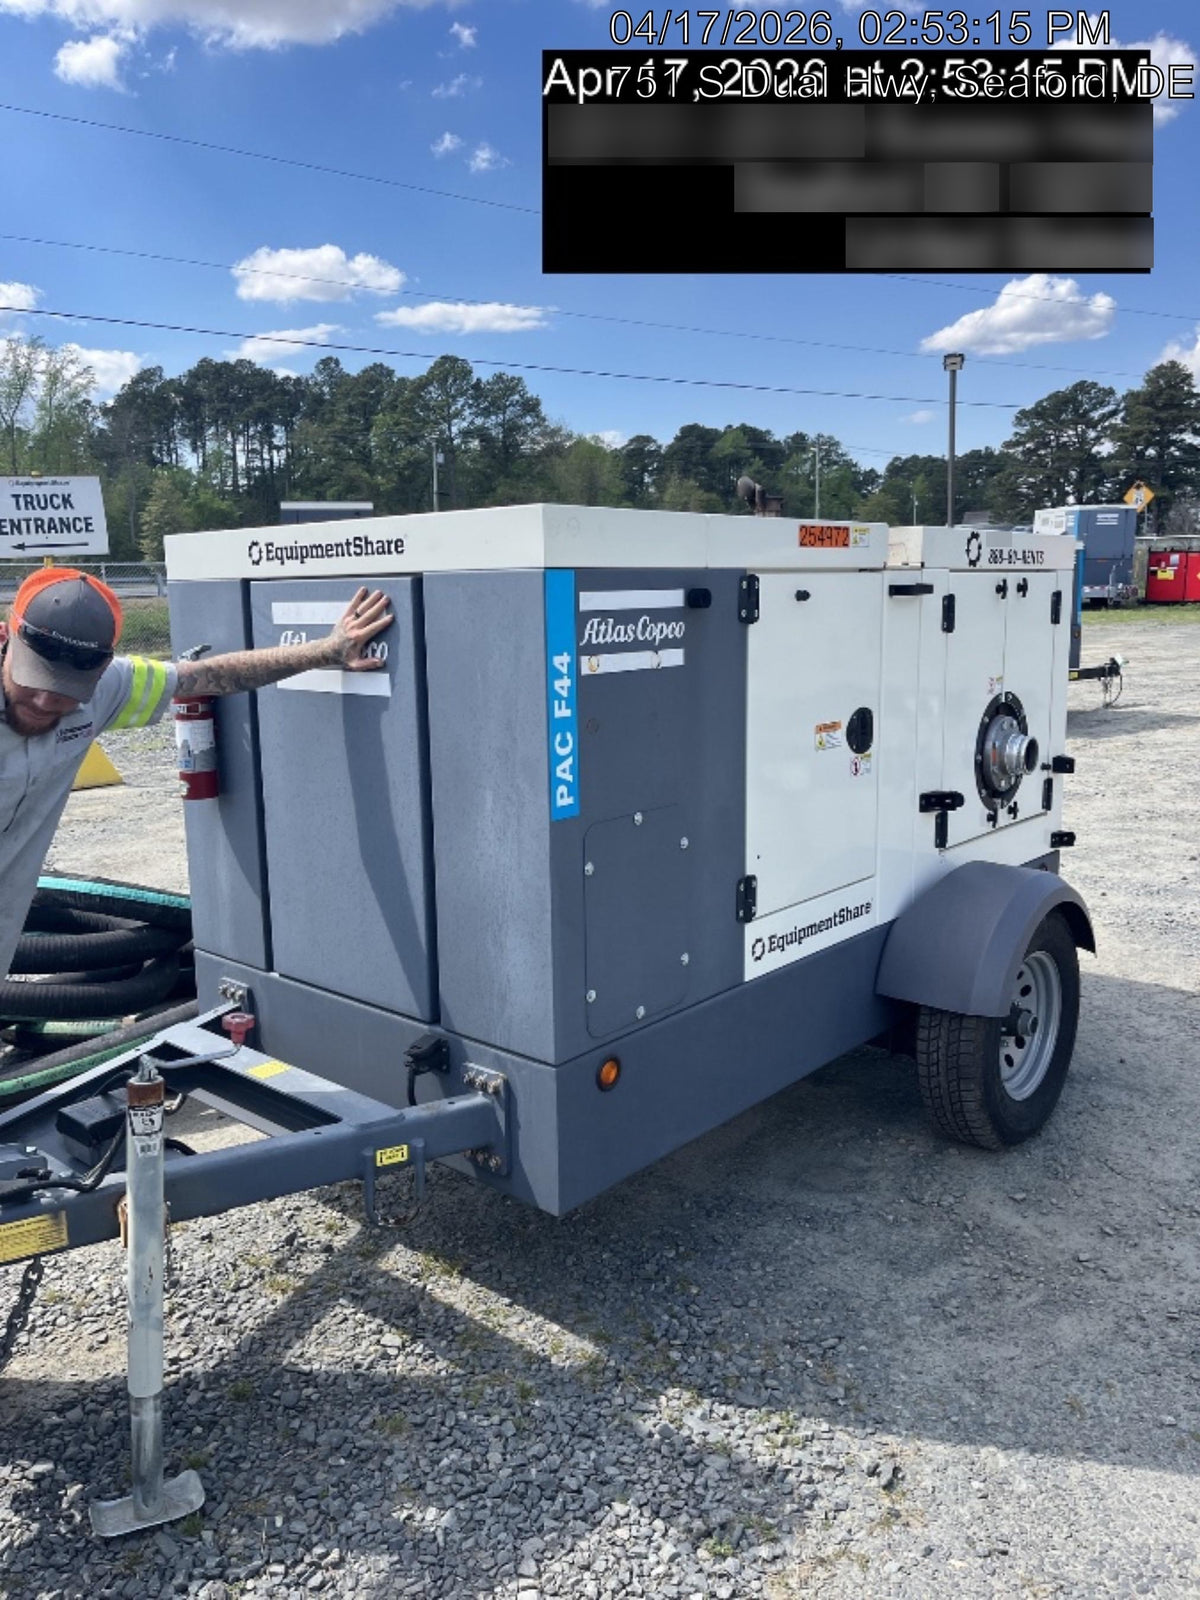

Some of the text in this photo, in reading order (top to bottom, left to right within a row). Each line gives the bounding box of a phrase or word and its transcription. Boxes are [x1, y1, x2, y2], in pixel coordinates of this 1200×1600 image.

[10, 493, 75, 511] TRUCK
[0, 516, 95, 536] ENTRANCE
[800, 525, 849, 547] 254972
[265, 534, 405, 566] EquipmentShare
[552, 651, 574, 808] PAC F44
[767, 901, 872, 953] EquipmentShare
